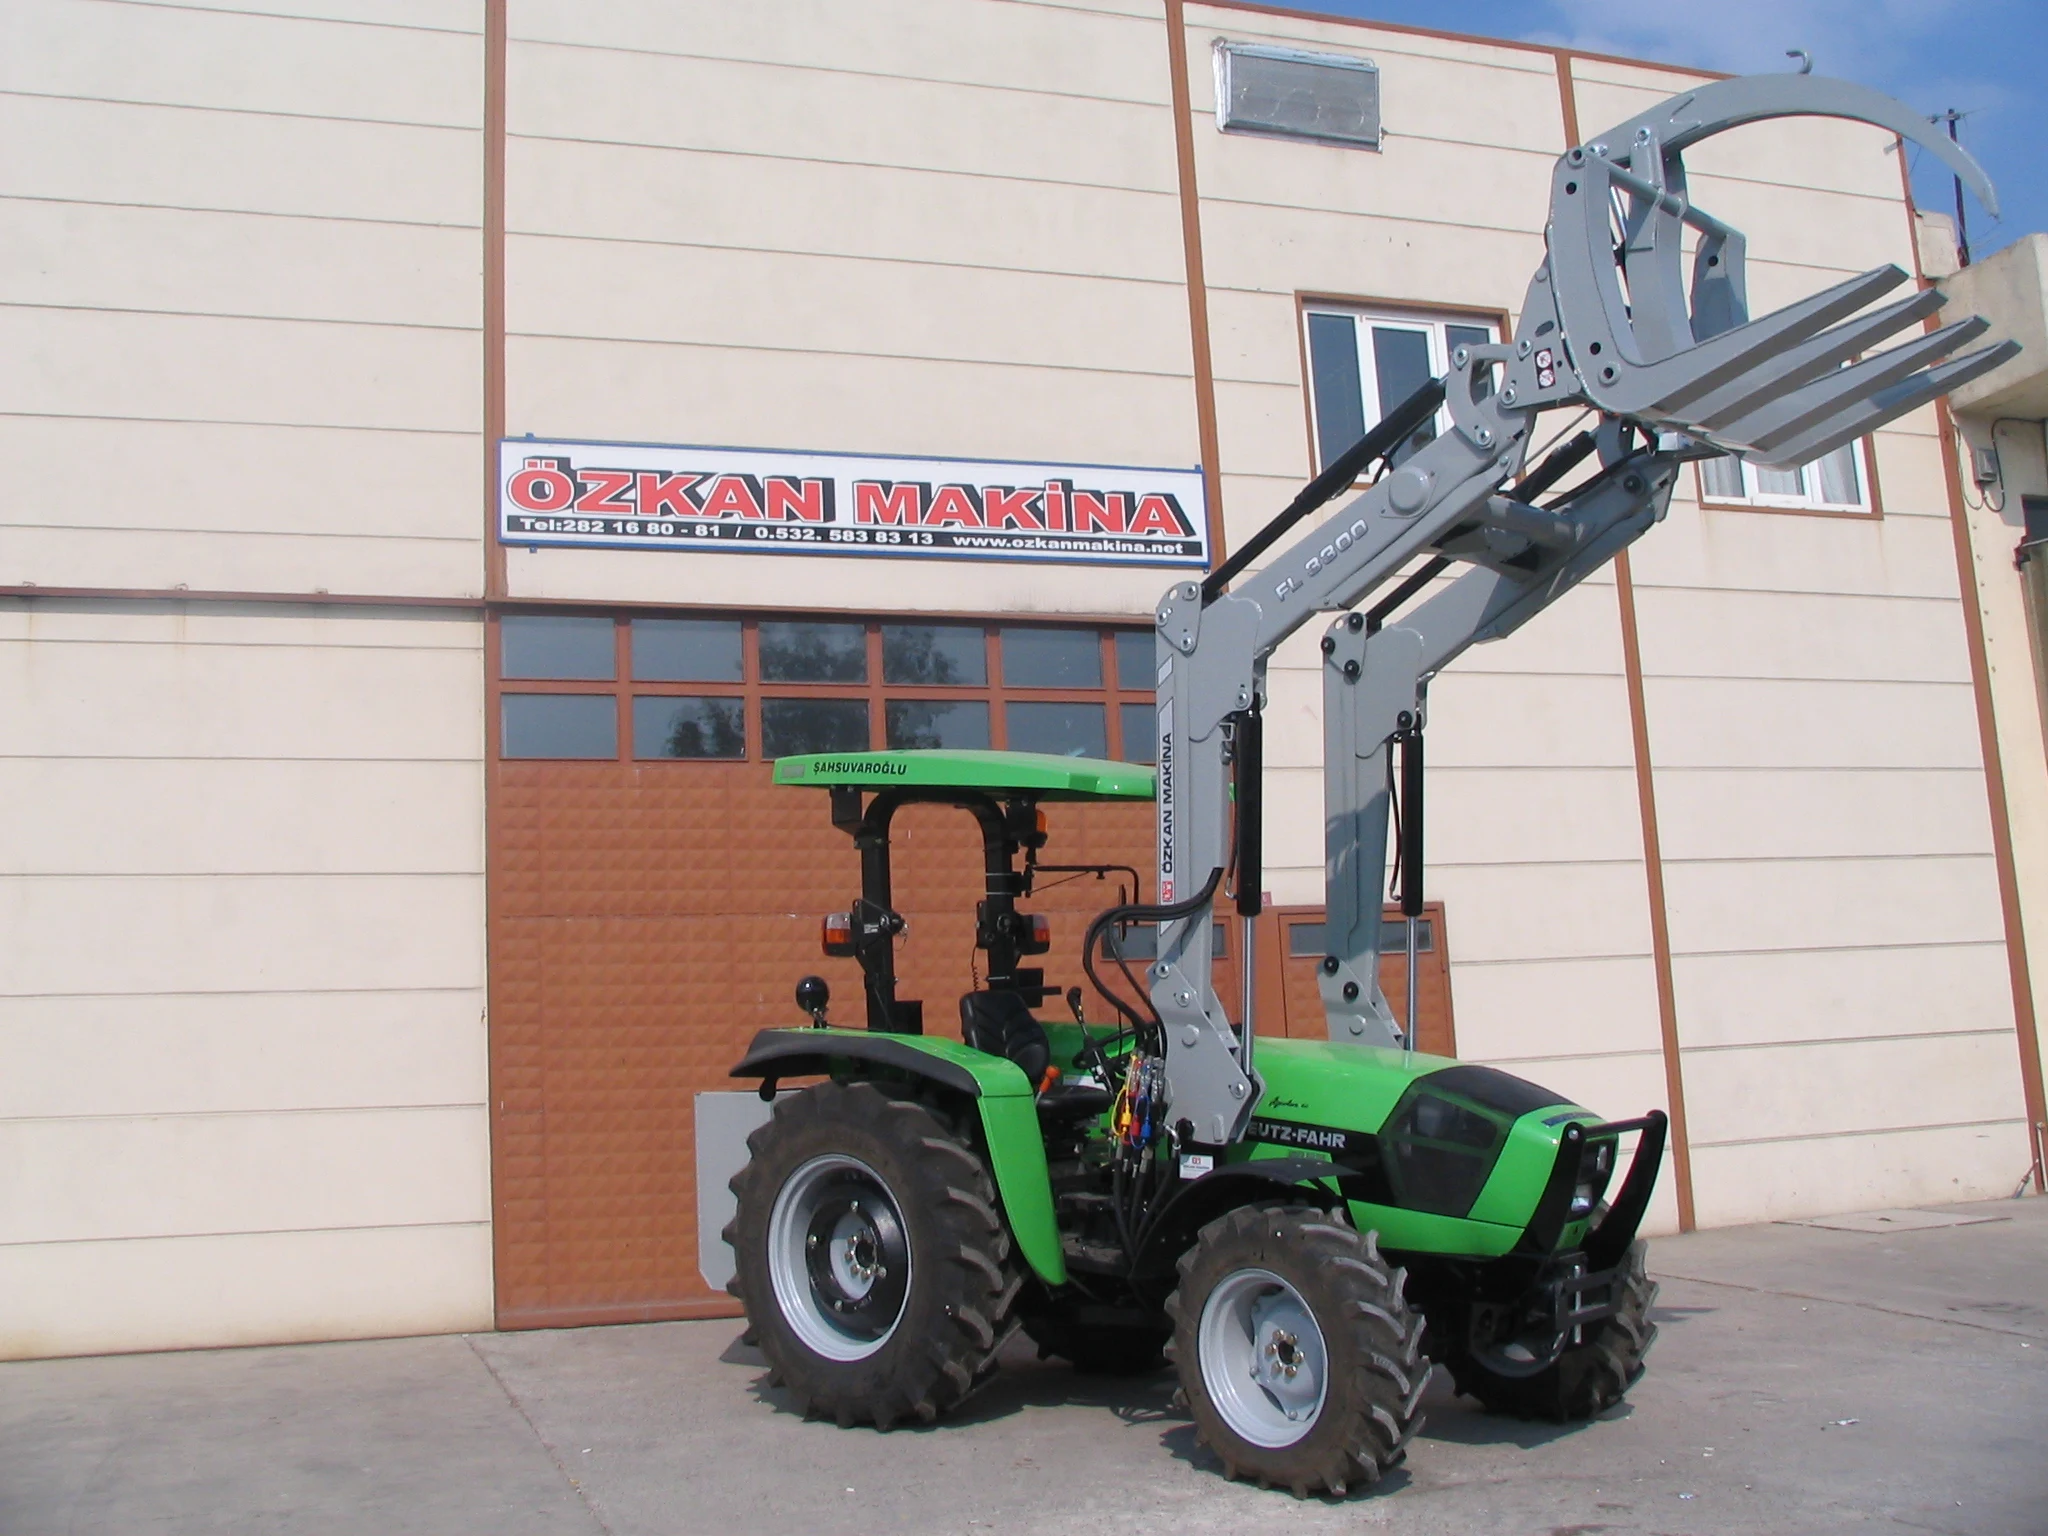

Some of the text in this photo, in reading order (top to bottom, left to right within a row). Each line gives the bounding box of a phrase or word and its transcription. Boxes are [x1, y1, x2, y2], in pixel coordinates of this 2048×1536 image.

[506, 456, 1197, 537] ÖZKAN MAKİNA
[519, 517, 605, 533] Tel:282
[612, 521, 639, 534] 16
[646, 522, 674, 535] 80
[694, 525, 720, 537] 81
[735, 526, 742, 538] /
[754, 526, 822, 541] 0.532.
[829, 531, 869, 543] 583
[875, 532, 901, 544] 83
[908, 534, 934, 545] 13
[952, 536, 1183, 555] www.ozkanmakina.net
[1274, 519, 1369, 602] FL 3300
[813, 761, 907, 776] ŞAHSUVAROĞLU
[1161, 733, 1173, 805] MAKİNA
[1161, 809, 1173, 874] ÖZKAN
[1247, 1121, 1346, 1149] EUTZ-FAHR
